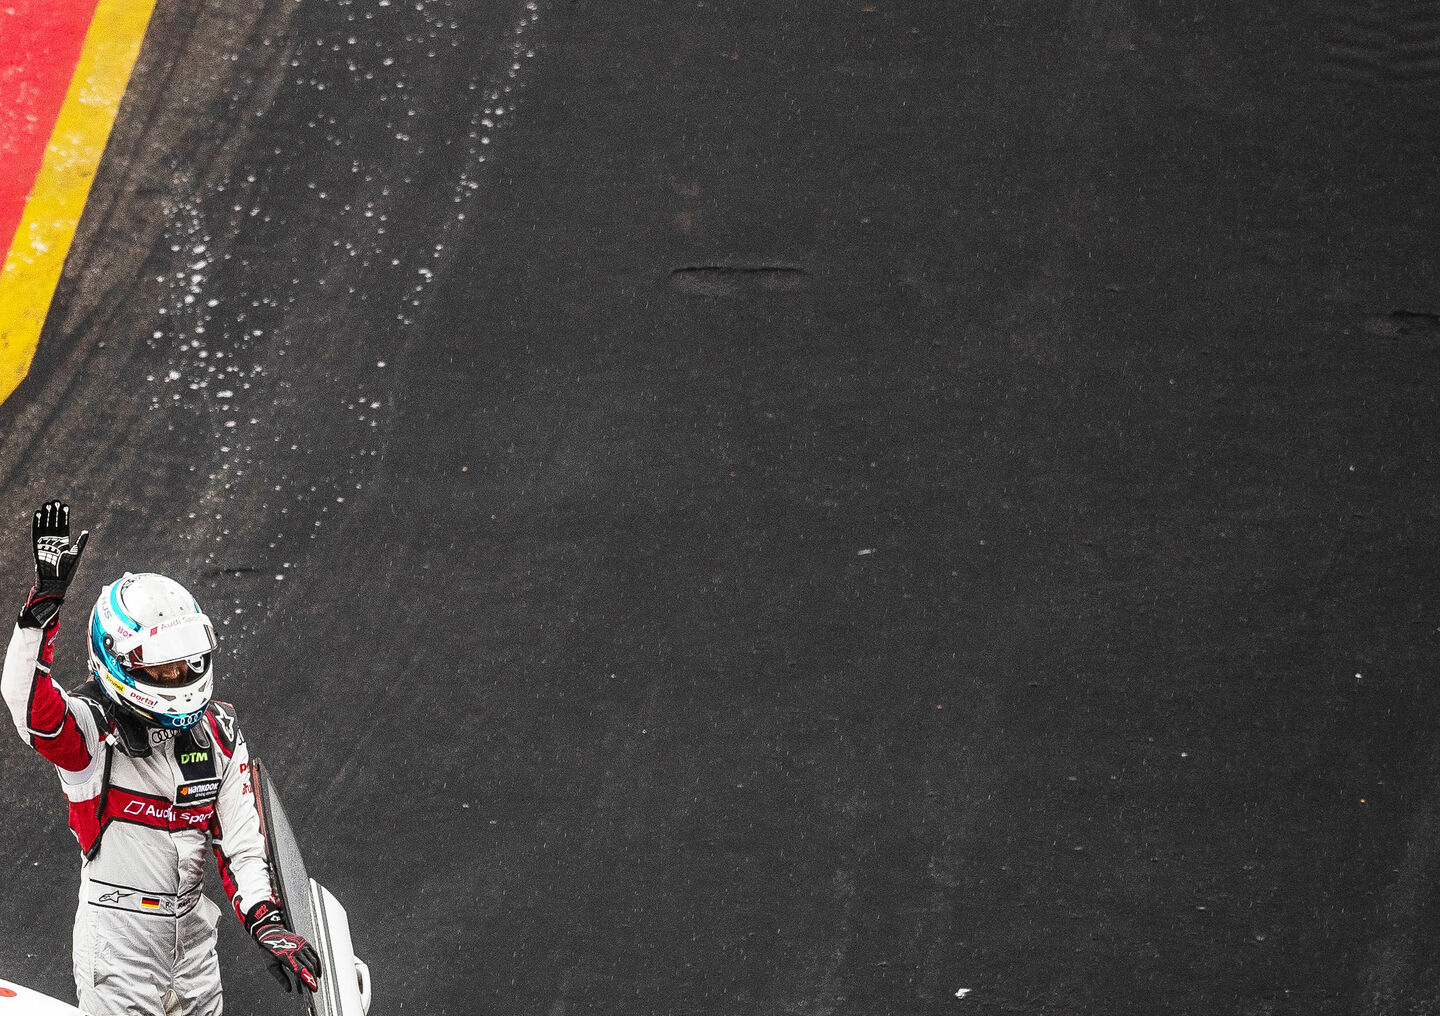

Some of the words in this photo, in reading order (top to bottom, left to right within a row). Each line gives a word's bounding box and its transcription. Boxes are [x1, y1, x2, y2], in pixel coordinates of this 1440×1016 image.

[180, 752, 208, 765] DTM
[145, 804, 176, 822] Audi
[180, 810, 214, 824] Sport
